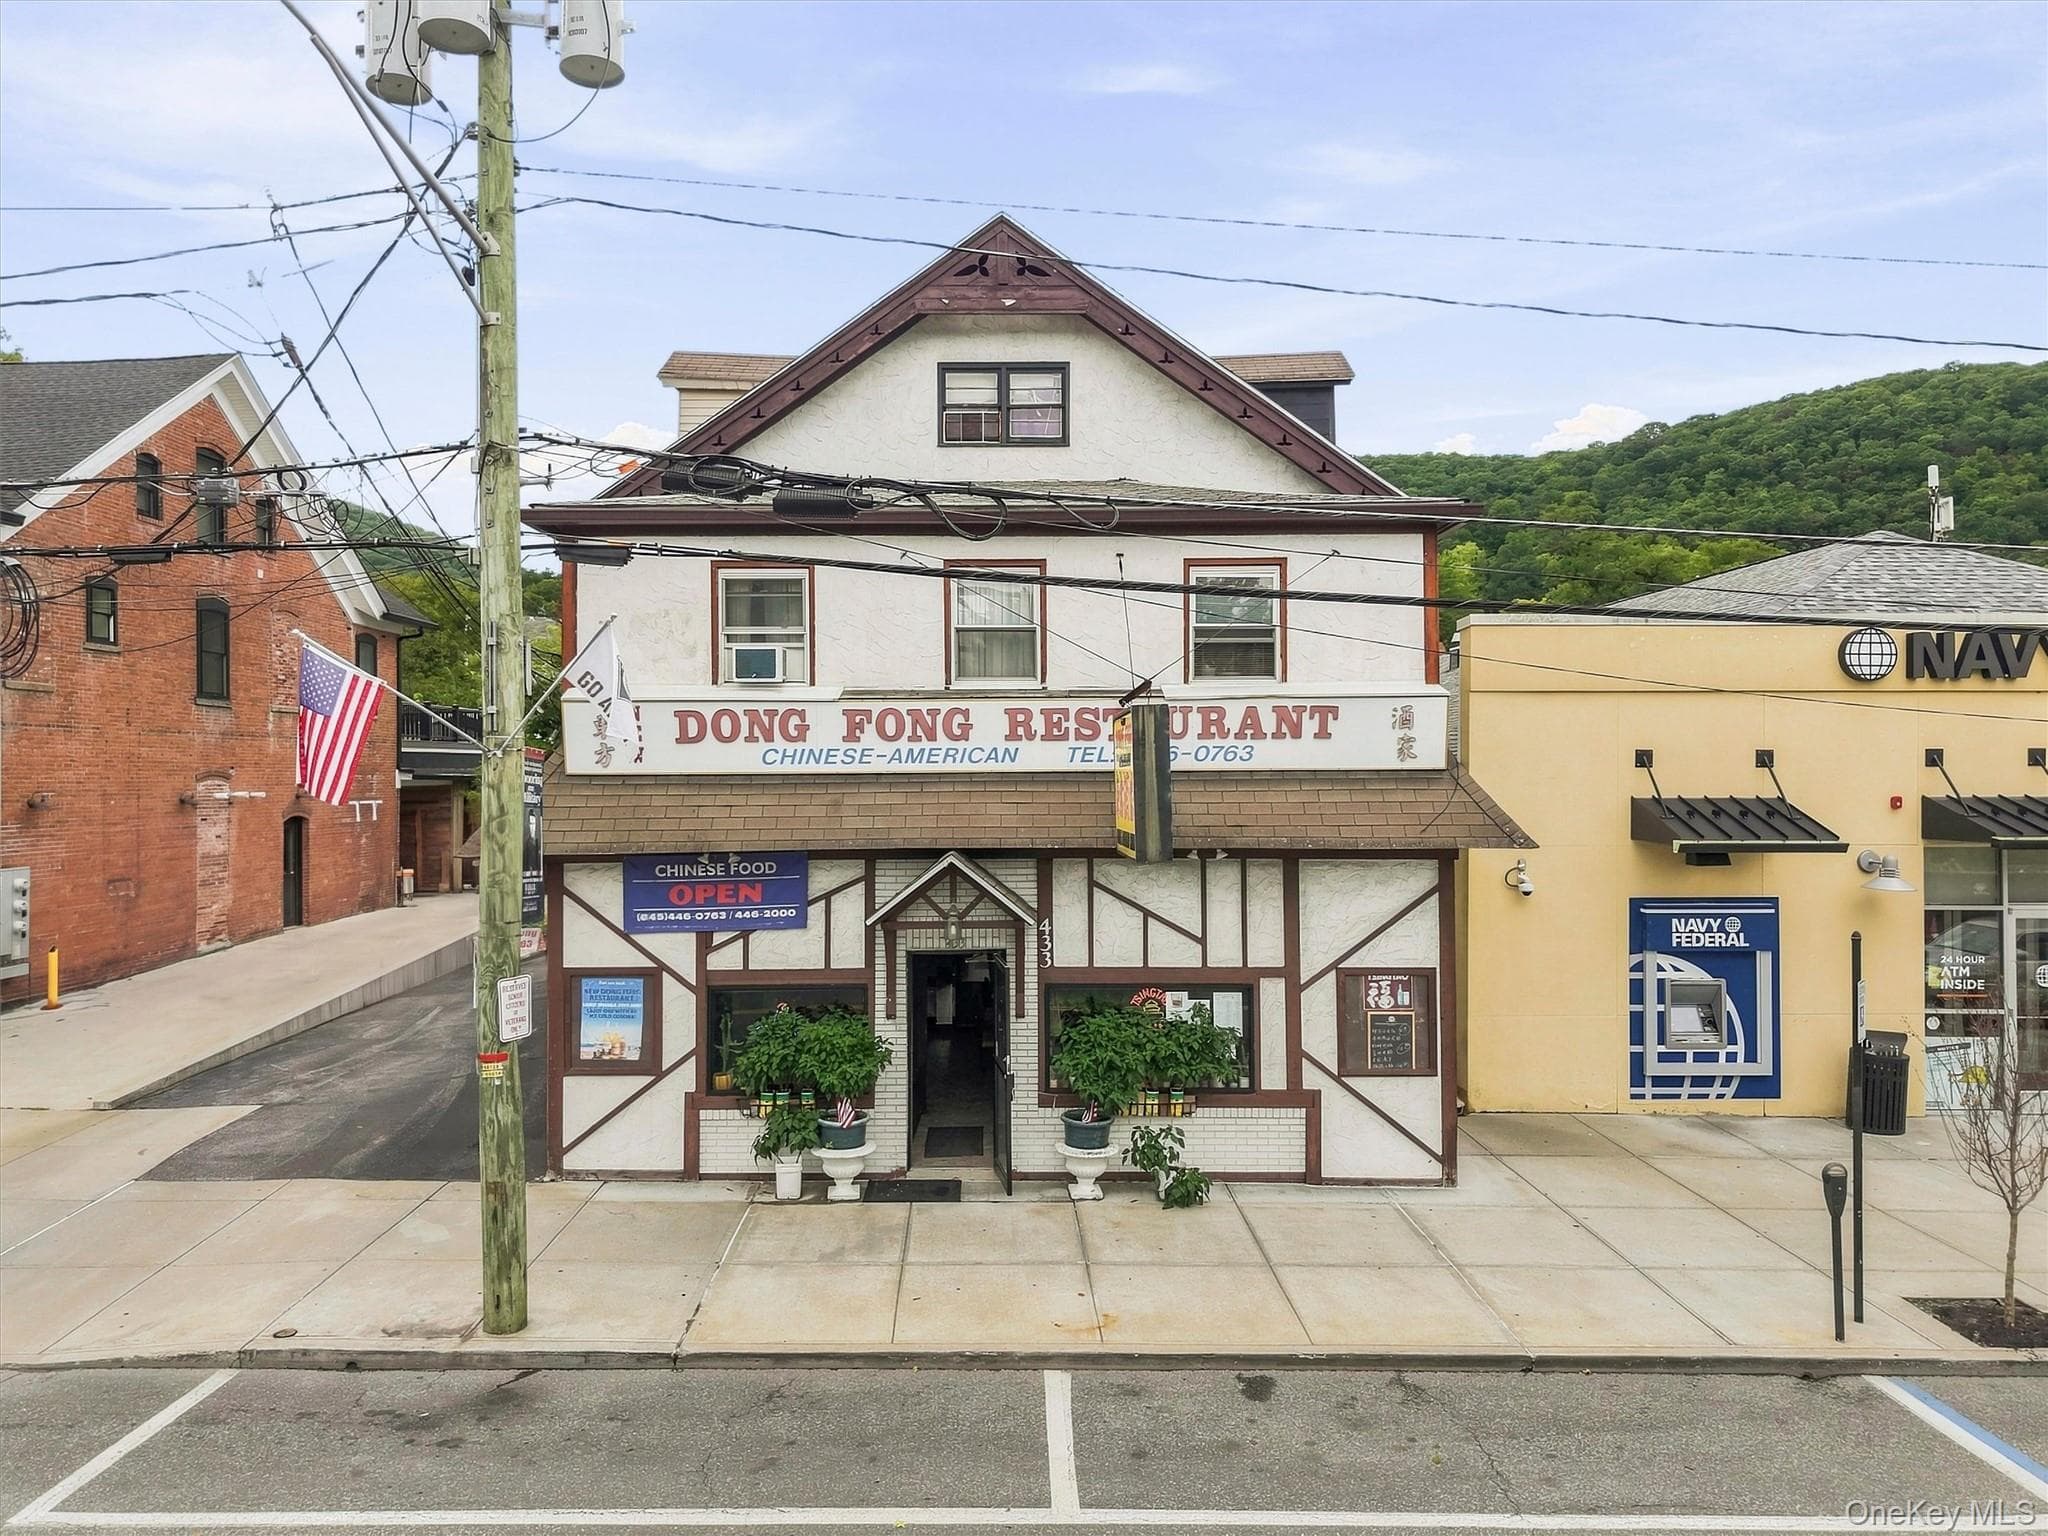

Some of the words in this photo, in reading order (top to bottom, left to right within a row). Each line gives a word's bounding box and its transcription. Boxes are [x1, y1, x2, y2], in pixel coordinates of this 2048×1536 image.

[1906, 631, 2048, 679] NAV
[577, 670, 604, 698] GO
[673, 708, 811, 744] DONG
[841, 707, 974, 742] FONG
[761, 747, 1019, 765] CHINESE-AMERICAN
[655, 863, 725, 877] CHINESE
[730, 862, 777, 875] FOOD
[668, 882, 763, 906] OPEN
[1671, 918, 1722, 932] NAVY
[1039, 918, 1052, 968] 433
[1671, 932, 1750, 947] FEDERAL
[1940, 955, 1953, 964] 24
[1955, 955, 1985, 964] HOUR
[1940, 966, 1970, 977] ATM
[1940, 979, 1985, 990] INSIDE
